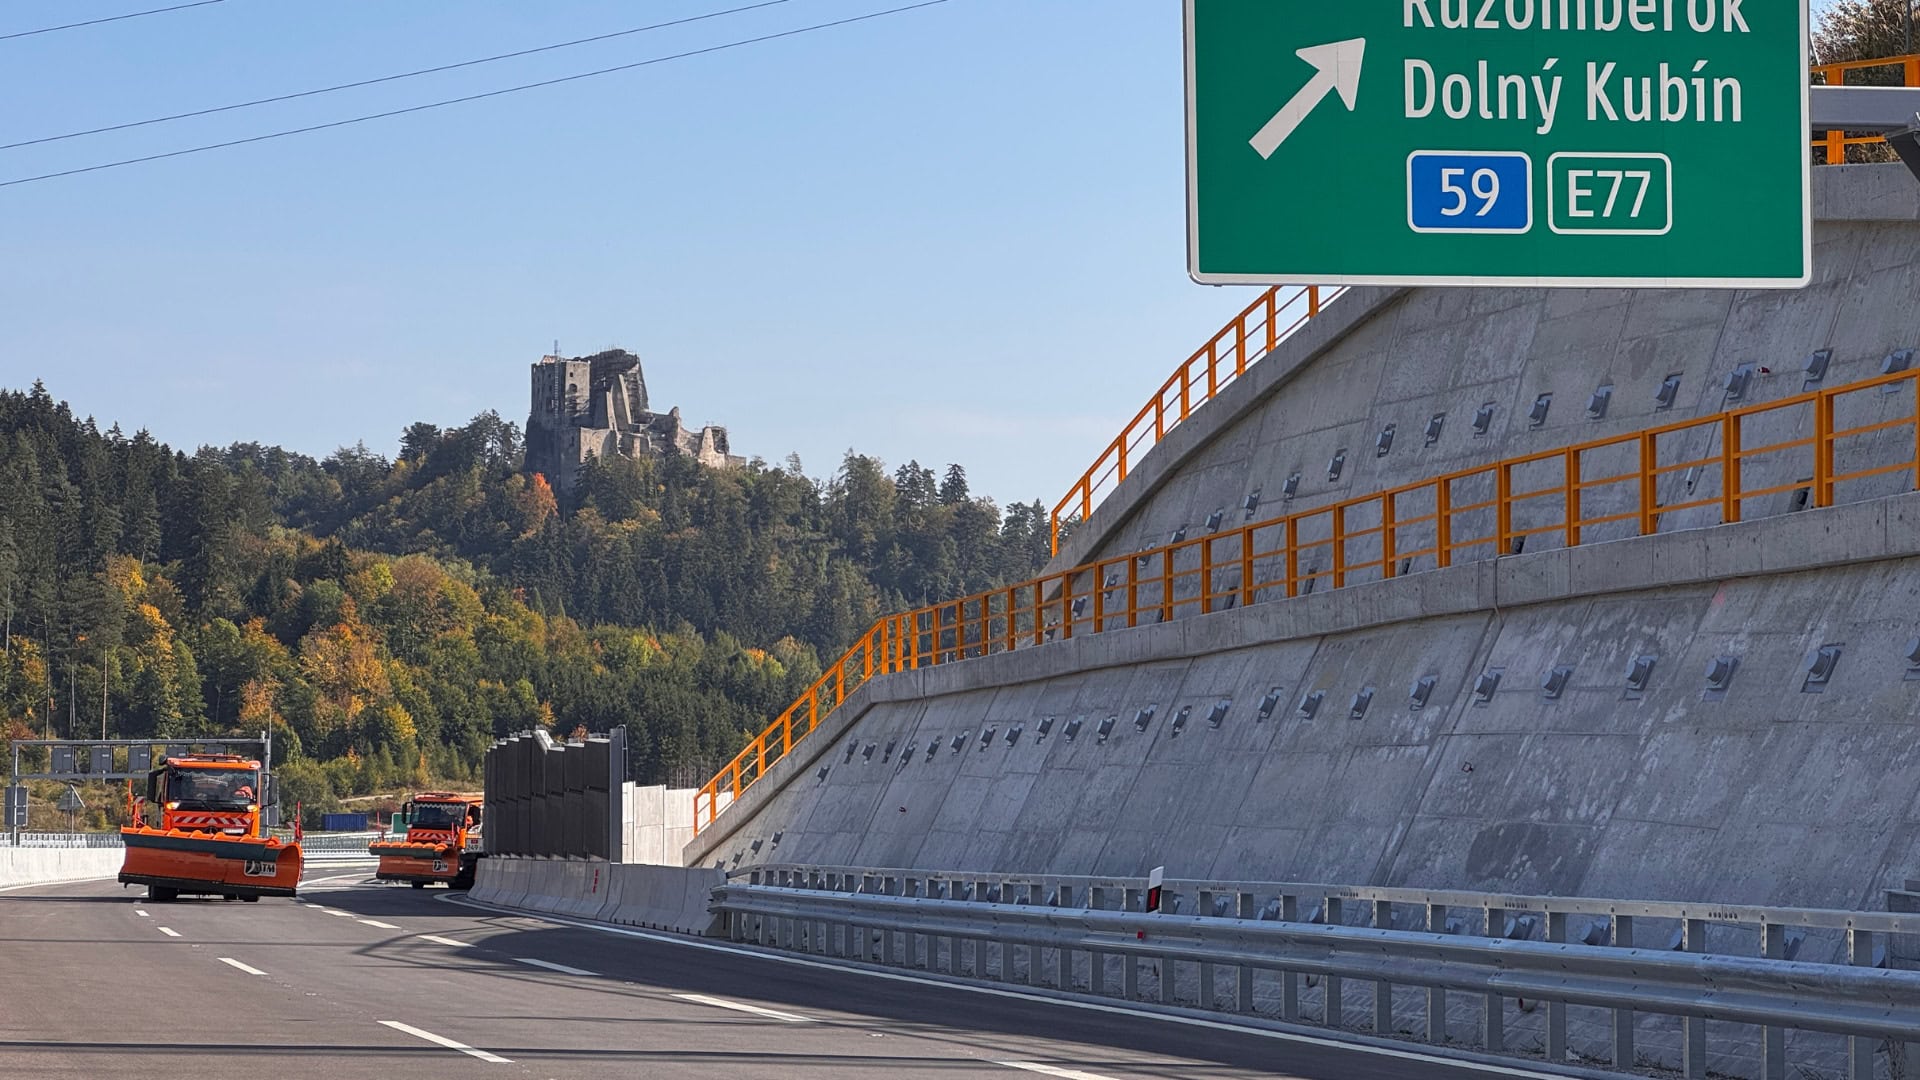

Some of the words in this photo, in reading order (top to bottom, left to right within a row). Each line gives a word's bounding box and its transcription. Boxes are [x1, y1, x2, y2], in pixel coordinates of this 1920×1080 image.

[1404, 58, 1563, 135] Dolný
[1586, 59, 1742, 122] Kubín
[1440, 168, 1500, 217] 59
[1568, 169, 1651, 218] E77
